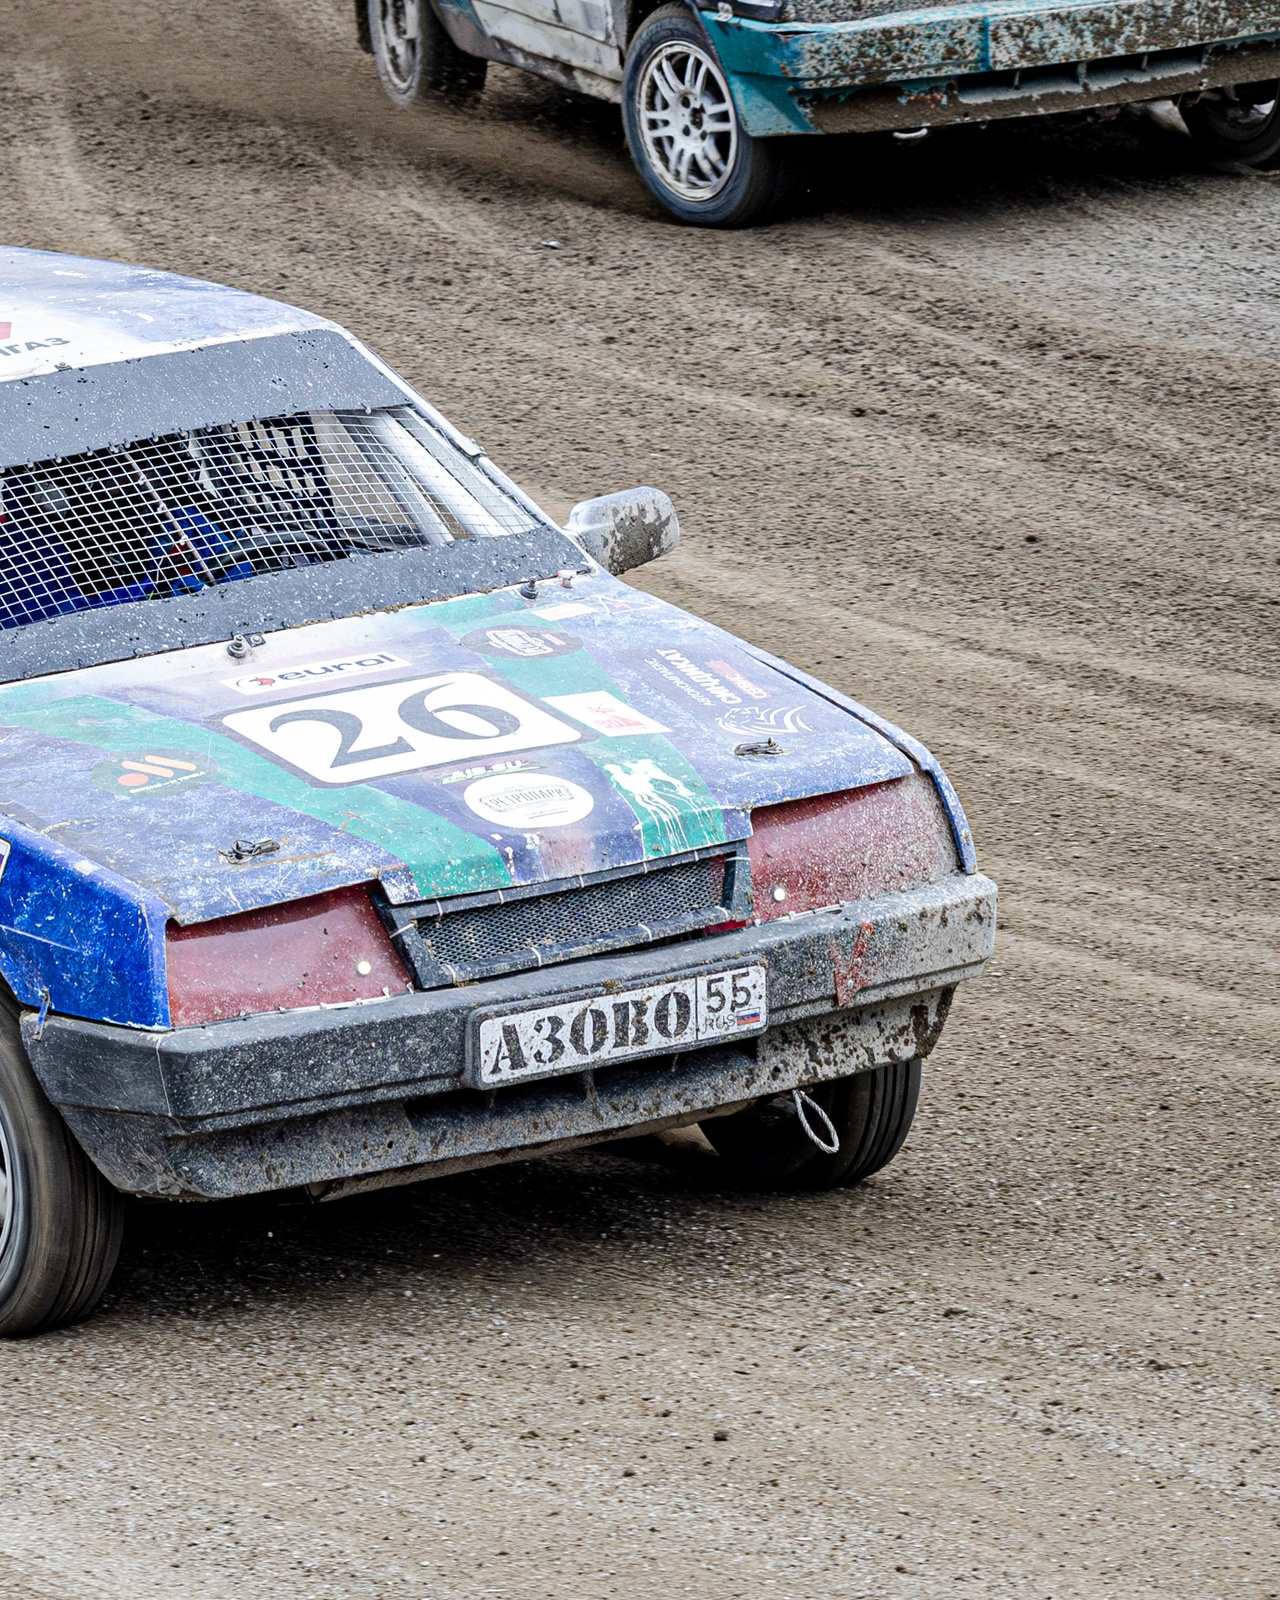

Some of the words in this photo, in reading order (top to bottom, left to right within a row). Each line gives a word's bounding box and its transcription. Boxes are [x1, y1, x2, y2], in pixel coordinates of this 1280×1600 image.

[277, 654, 396, 680] eurol
[655, 649, 743, 704] СИНДИКАТ
[269, 681, 521, 769] 26
[706, 972, 752, 1013] 55
